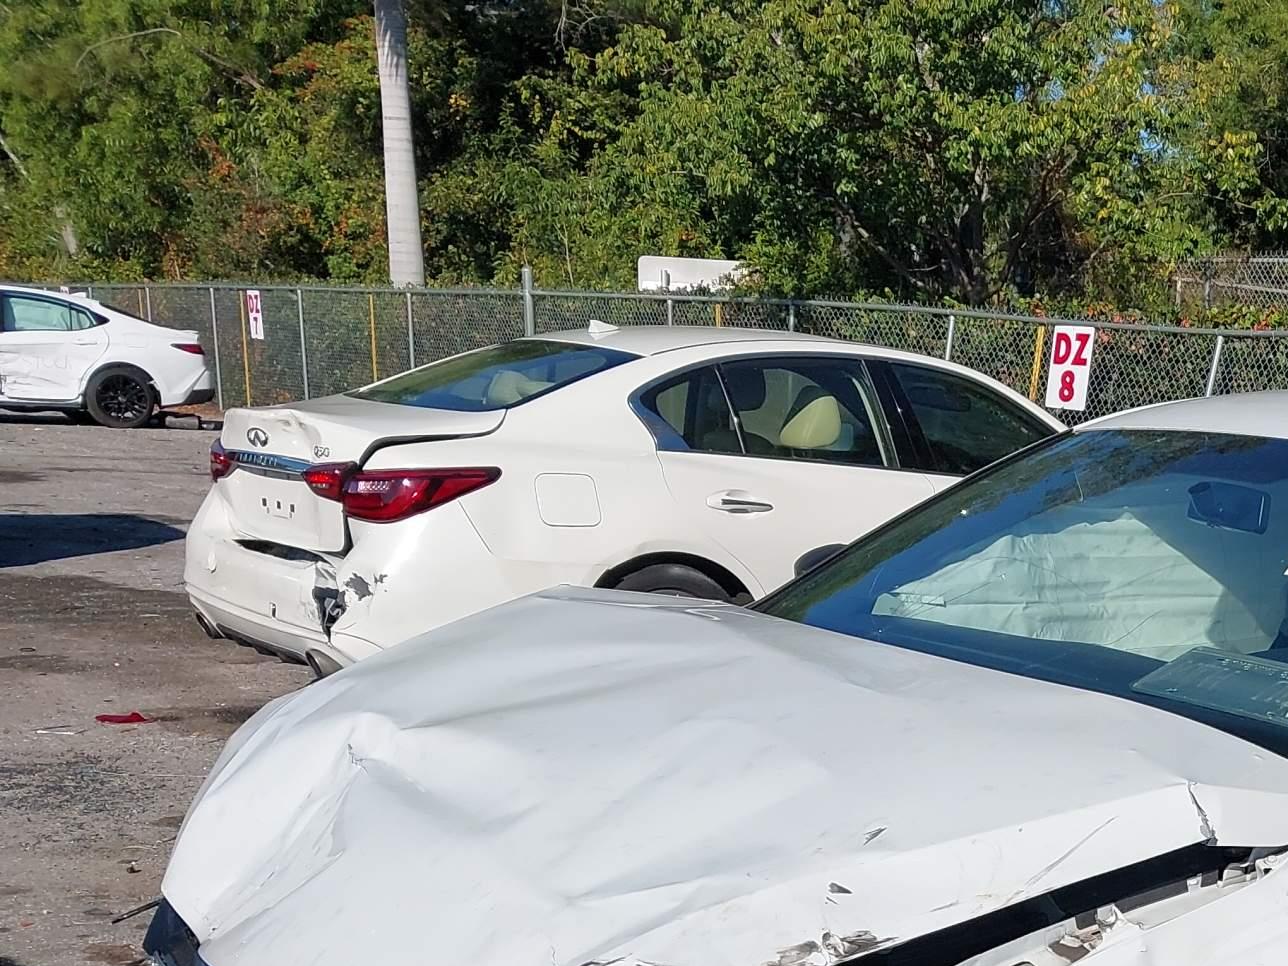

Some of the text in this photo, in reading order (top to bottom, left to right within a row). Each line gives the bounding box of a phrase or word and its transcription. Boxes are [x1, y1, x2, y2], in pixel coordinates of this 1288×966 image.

[247, 294, 260, 314] DZ
[1053, 332, 1090, 366] DZ
[1058, 370, 1075, 402] 8
